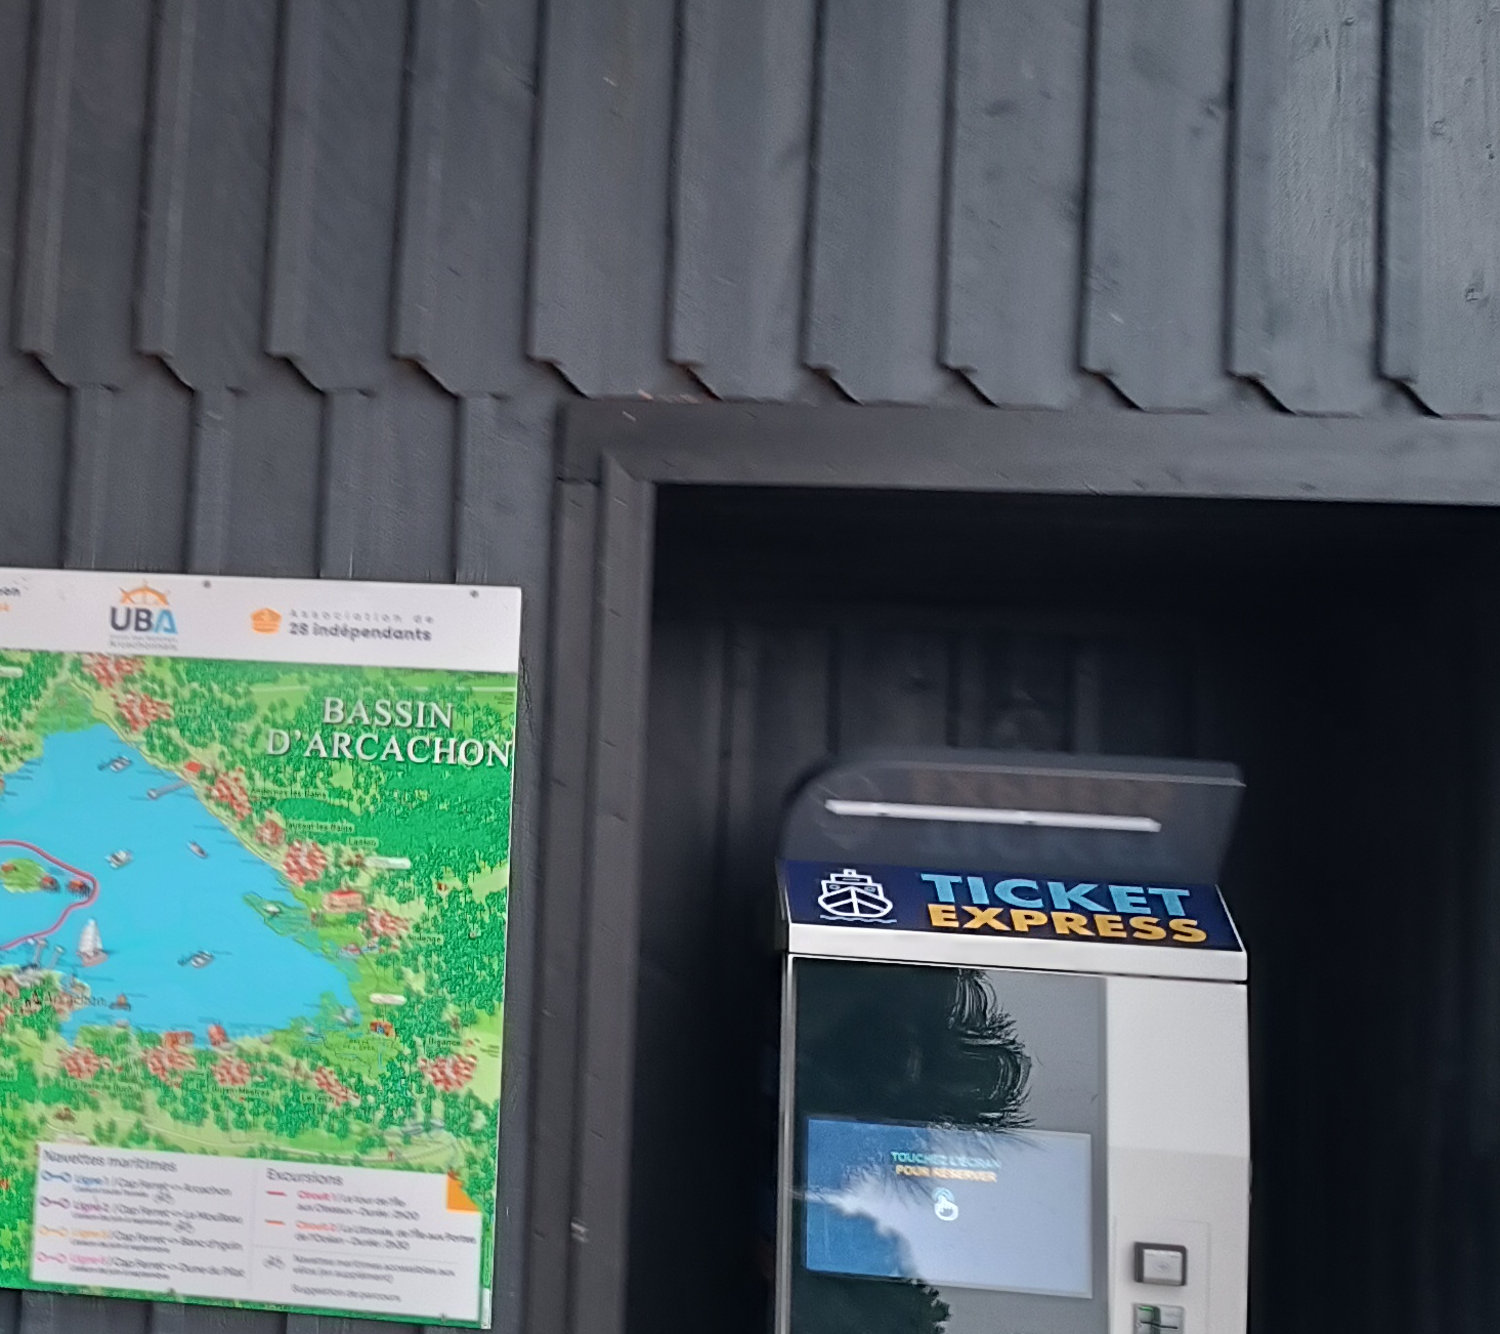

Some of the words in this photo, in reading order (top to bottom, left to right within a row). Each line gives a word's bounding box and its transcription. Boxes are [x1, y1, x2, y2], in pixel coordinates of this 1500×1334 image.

[110, 606, 178, 634] UBA
[289, 622, 309, 636] 28
[312, 623, 432, 642] indépendants
[322, 696, 454, 729] BASSIN
[265, 728, 515, 768] D'ARCACHON
[920, 873, 1191, 917] TICKET
[927, 903, 1207, 943] EXPRESS
